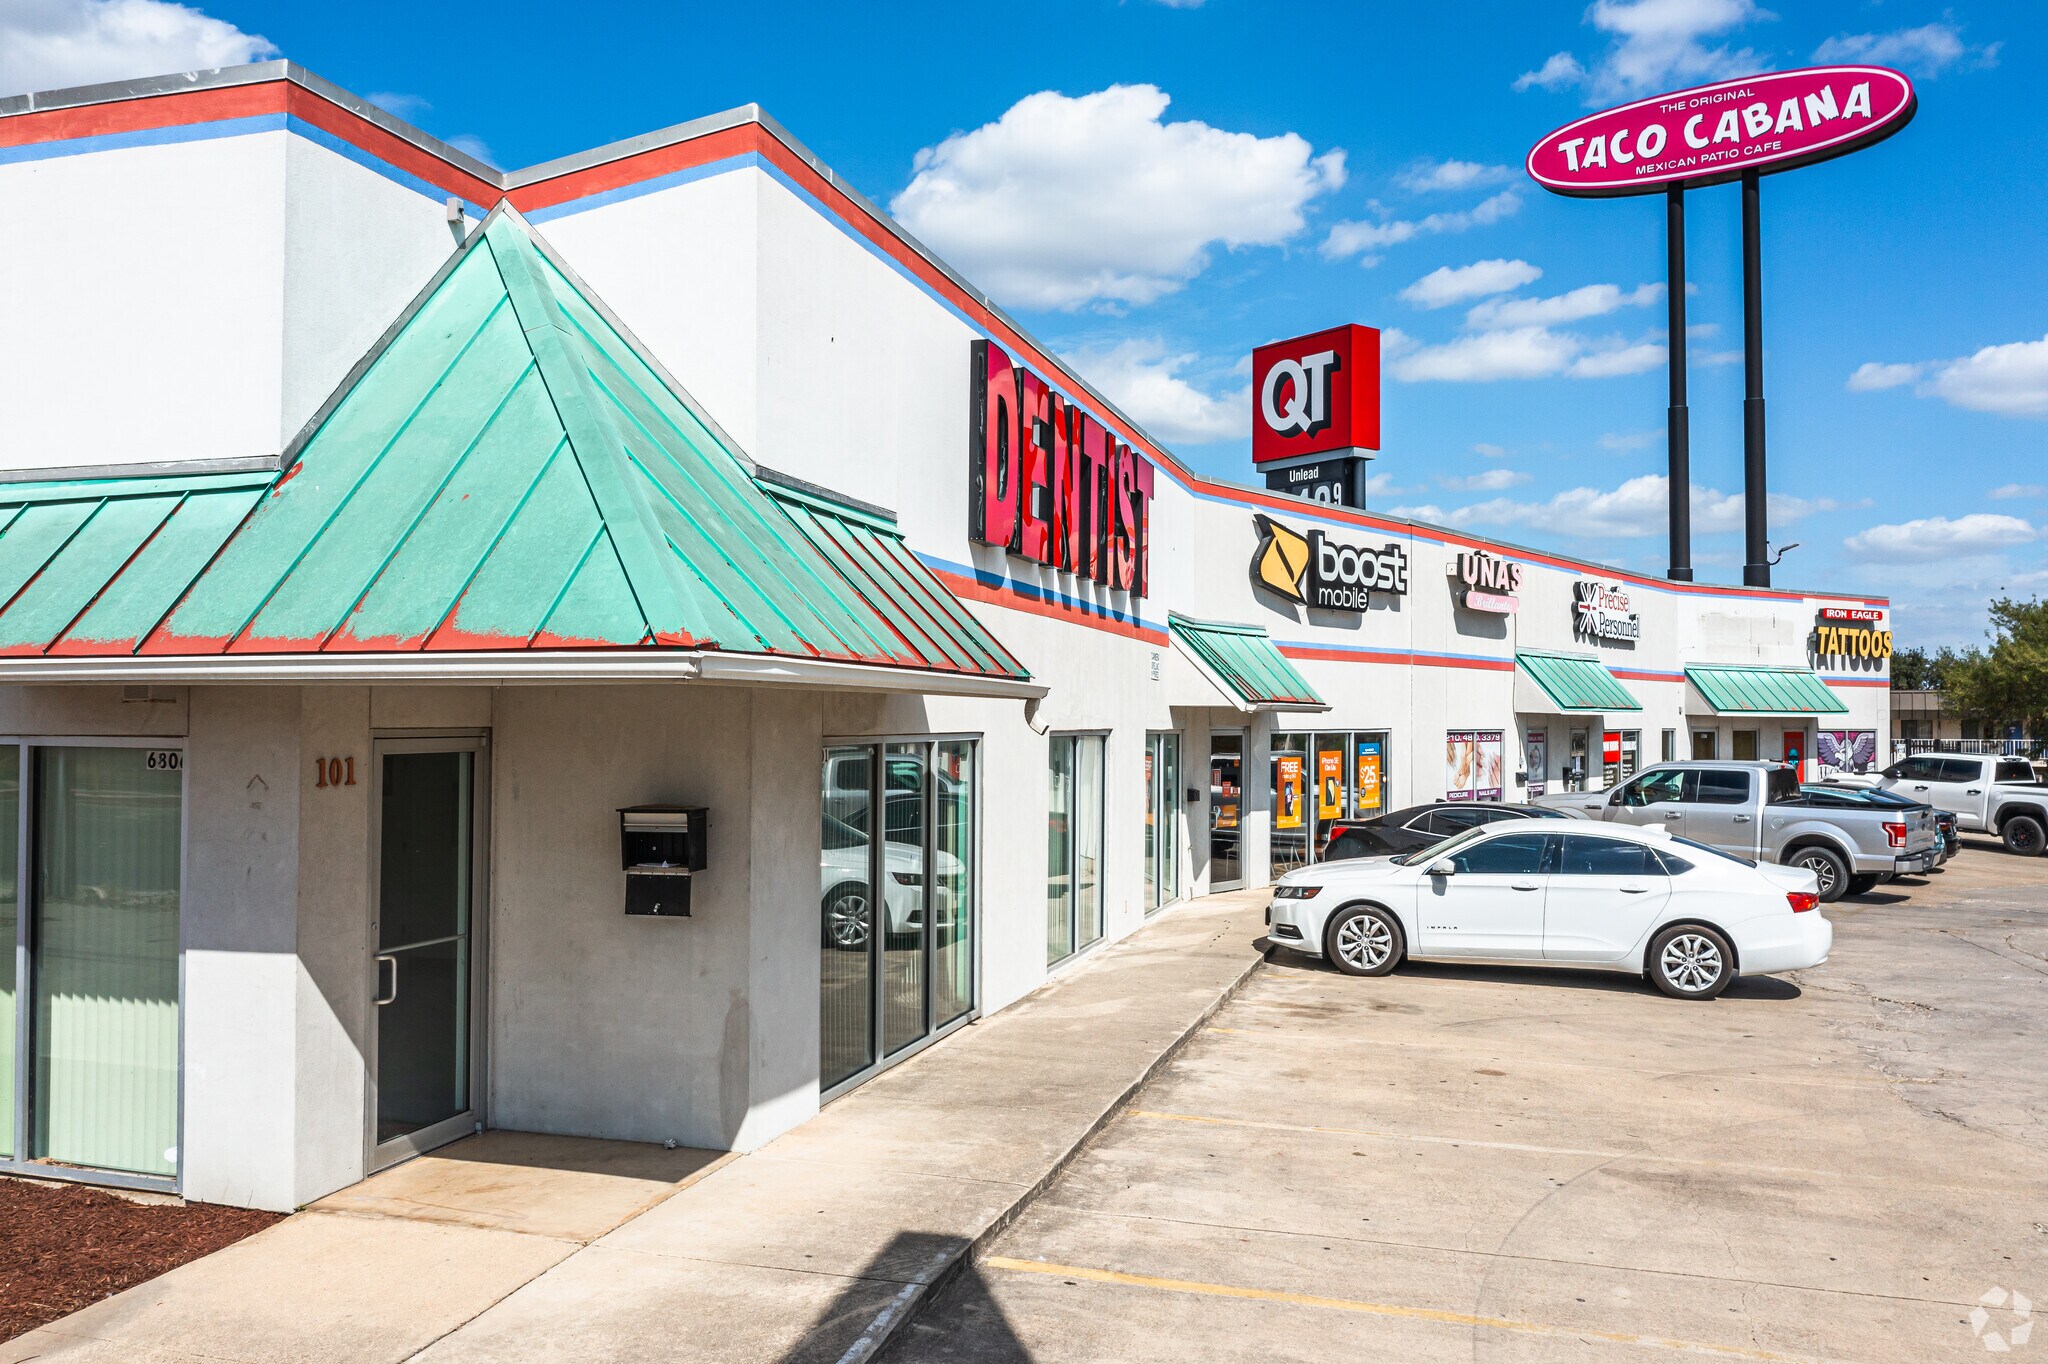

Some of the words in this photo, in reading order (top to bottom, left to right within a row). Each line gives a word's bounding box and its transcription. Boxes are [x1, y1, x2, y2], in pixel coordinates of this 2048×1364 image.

[1660, 101, 1687, 114] THE
[1689, 88, 1756, 108] ORIGINAL
[1558, 123, 1668, 173] TACO
[1683, 81, 1872, 149] CABANA
[1635, 156, 1697, 176] MEXICAN
[1700, 149, 1740, 164] PATIO
[1743, 140, 1782, 156] CAFE
[1261, 350, 1337, 435] QT
[972, 338, 1155, 600] DENTIST
[1289, 465, 1319, 483] Unlead
[1318, 535, 1405, 592] boost
[1461, 550, 1523, 592] UÑAS
[1318, 586, 1368, 609] mobile
[1598, 586, 1629, 612] Precise
[1599, 611, 1640, 638] Personnel
[1826, 609, 1847, 618] IRON
[1851, 610, 1879, 620] EAGLE
[1817, 626, 1893, 658] TATTOOS
[147, 751, 183, 769] 680
[315, 756, 357, 788] 101
[1281, 762, 1298, 772] FREE
